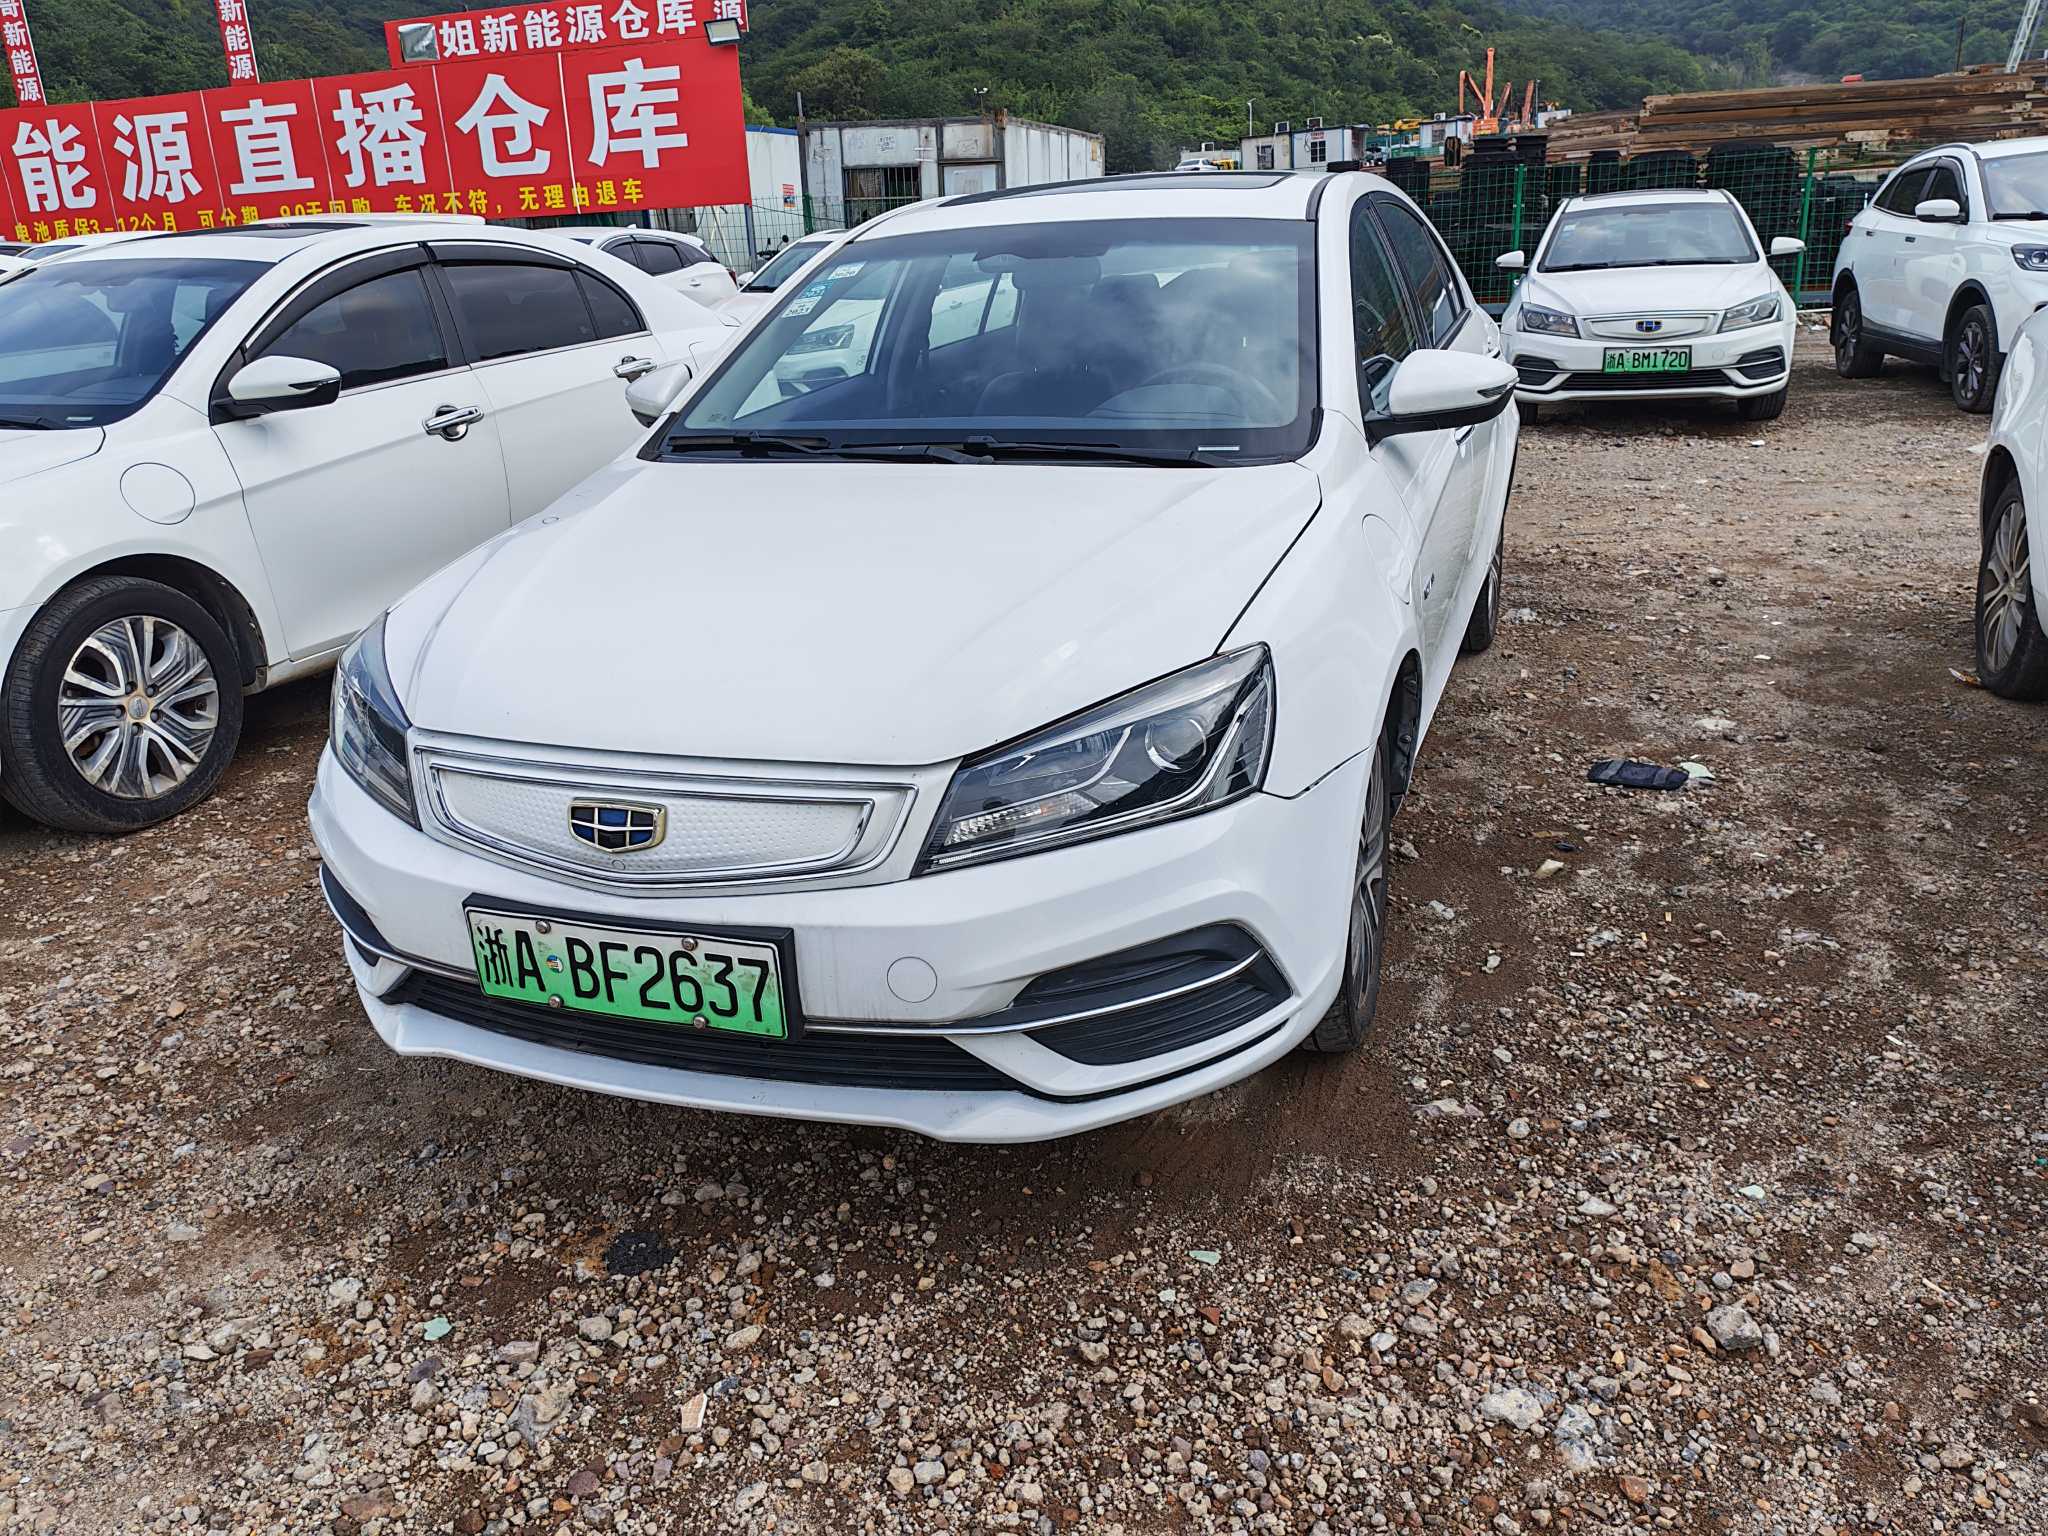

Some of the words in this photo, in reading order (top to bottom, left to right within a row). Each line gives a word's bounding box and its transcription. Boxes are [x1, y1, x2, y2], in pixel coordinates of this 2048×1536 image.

[12, 57, 689, 213] 能源直播仓库
[198, 206, 259, 228] 可分期
